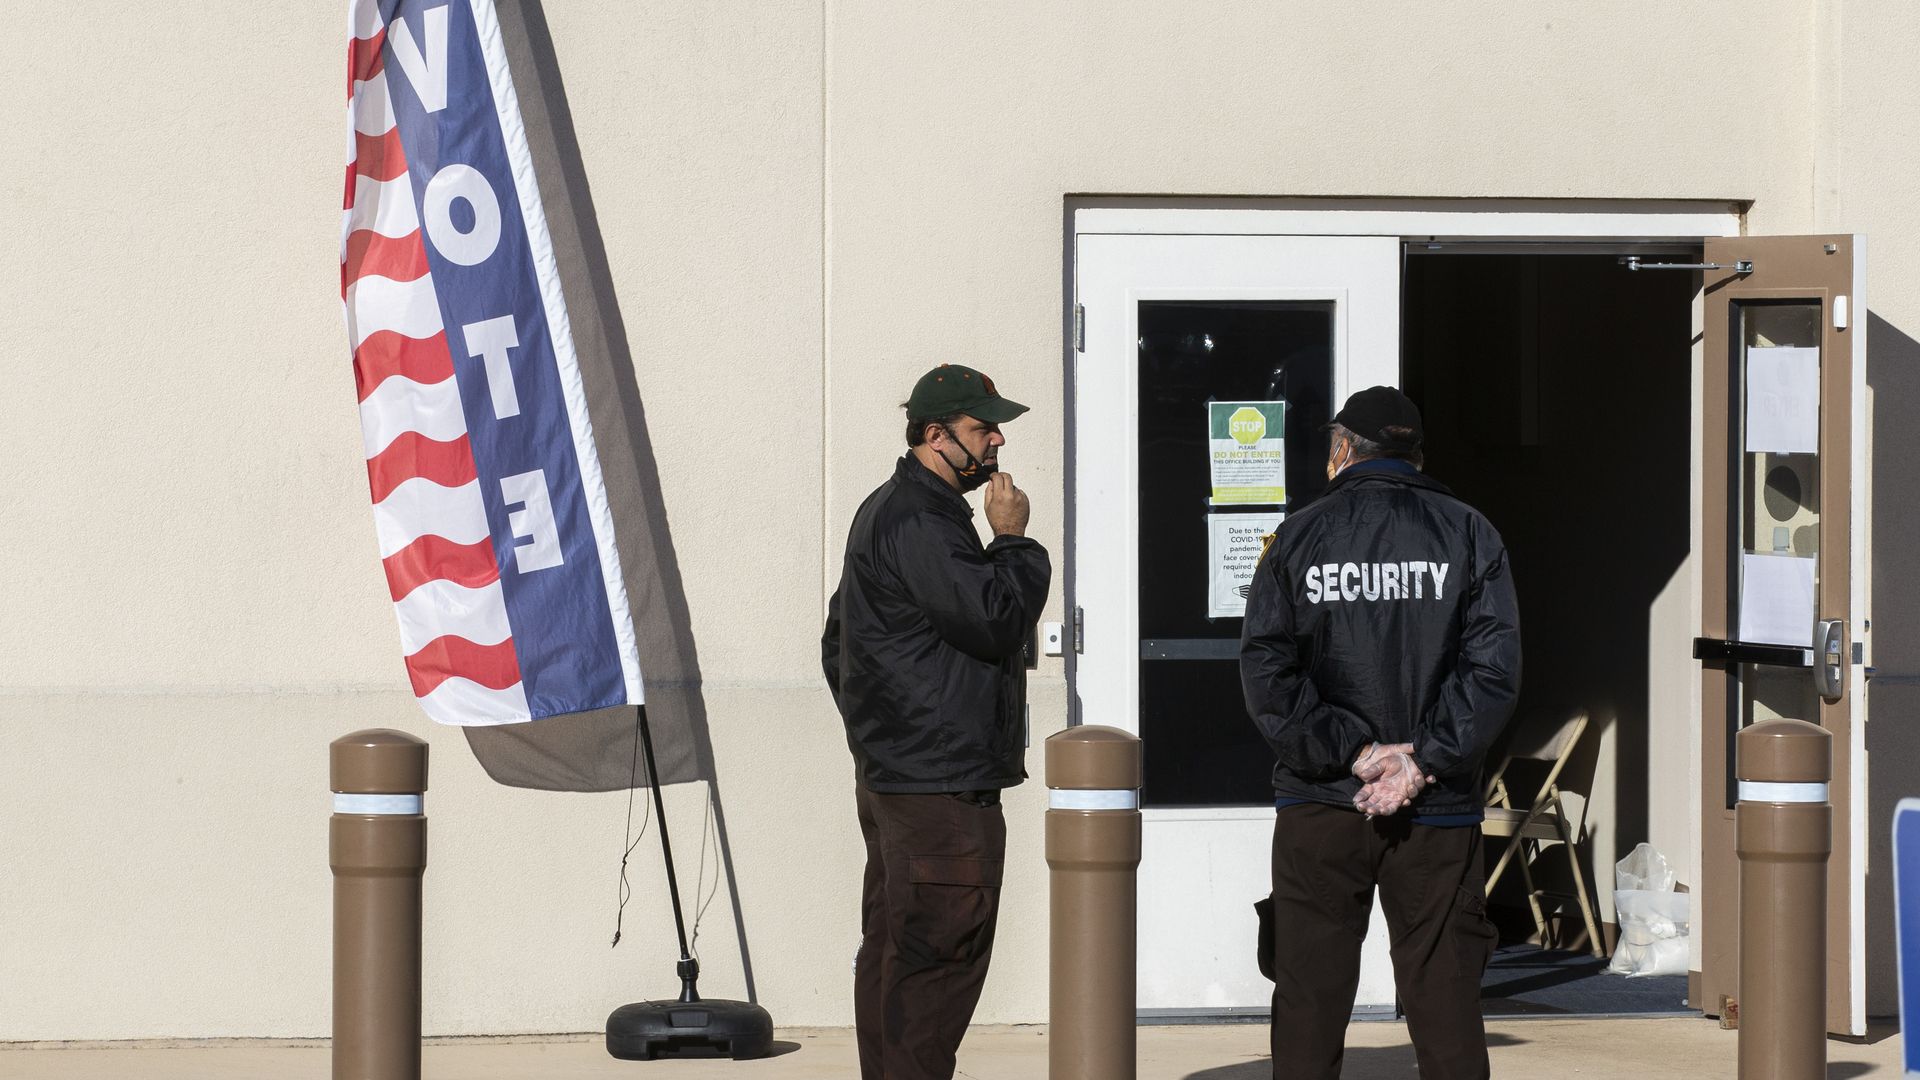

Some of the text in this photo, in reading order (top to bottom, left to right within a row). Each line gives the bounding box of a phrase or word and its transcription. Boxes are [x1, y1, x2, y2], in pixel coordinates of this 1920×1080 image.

[1233, 421, 1262, 432] STOP
[1251, 450, 1281, 458] ENTER
[1230, 545, 1262, 553] pandemic
[1223, 563, 1251, 571] required
[1305, 561, 1449, 604] SECURITY
